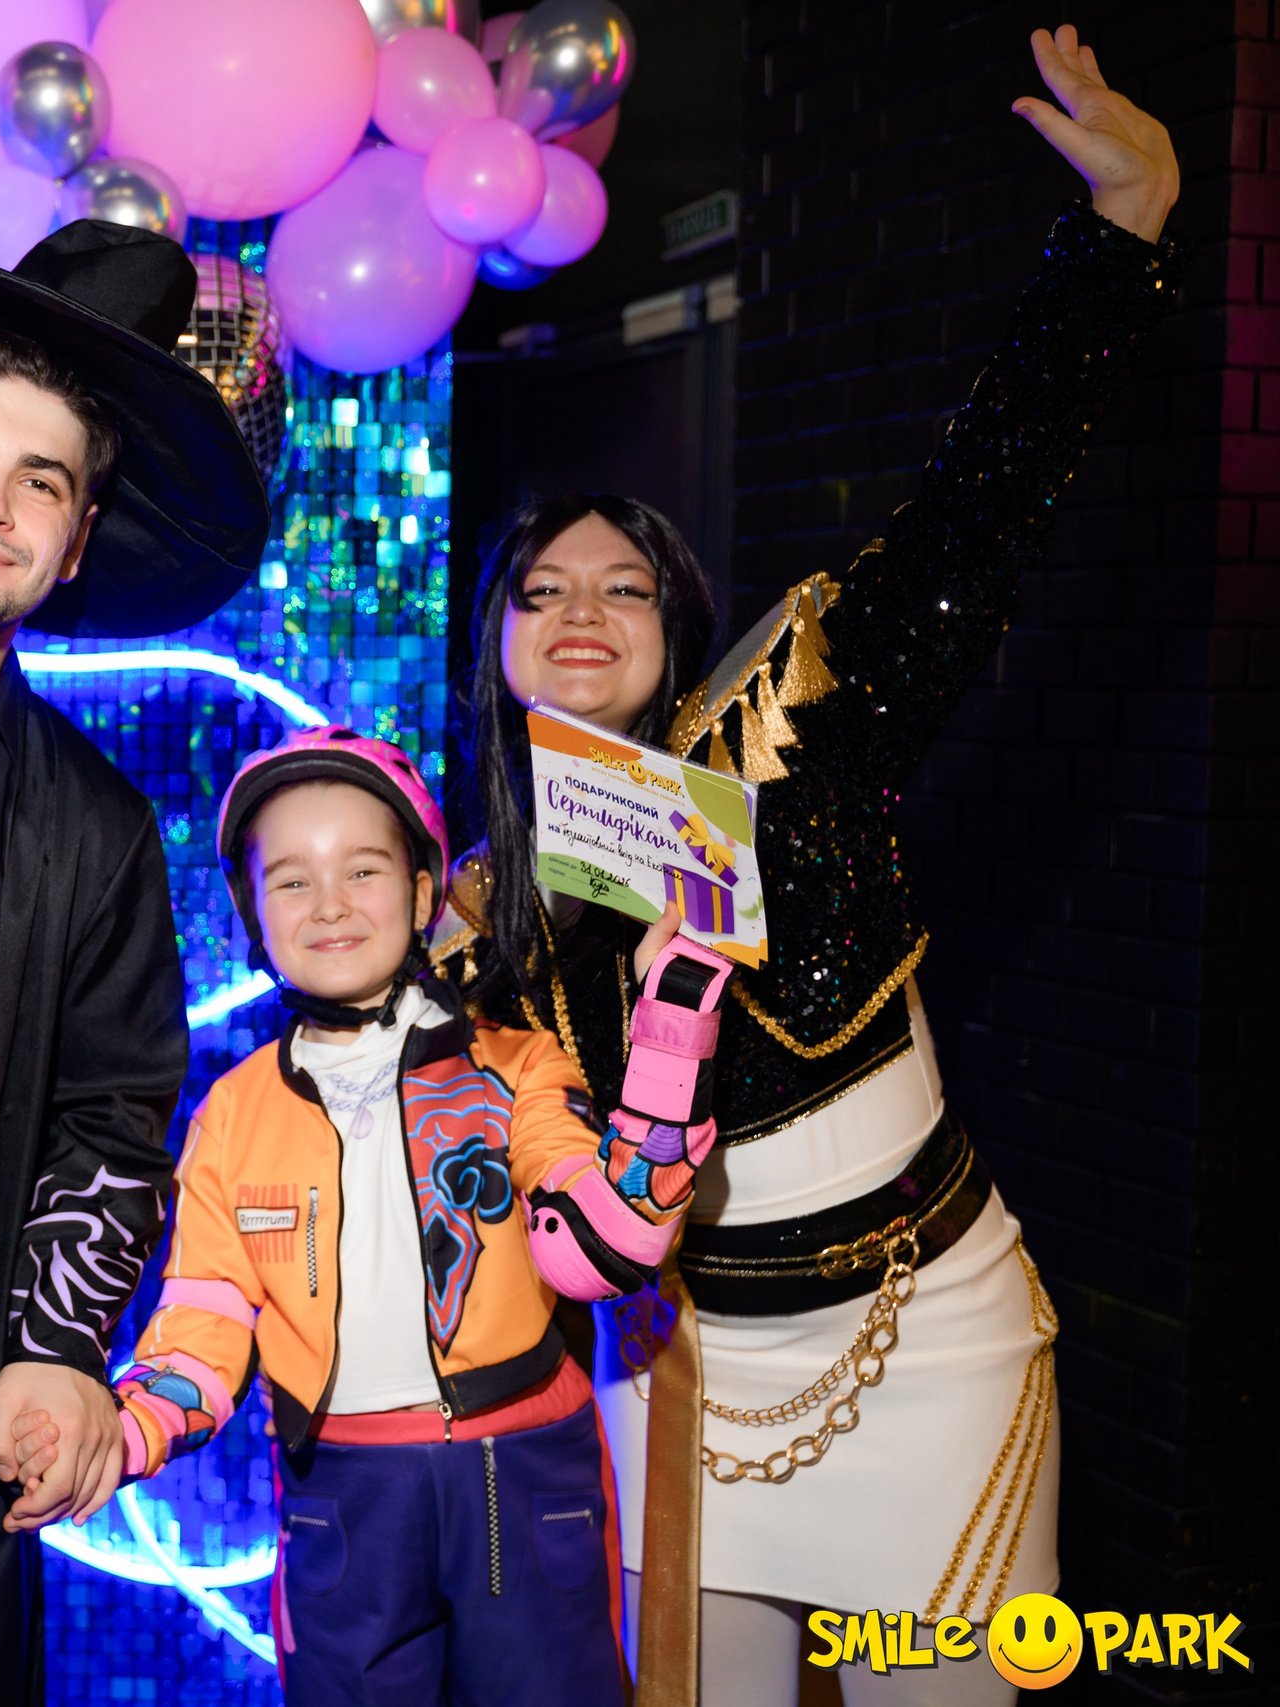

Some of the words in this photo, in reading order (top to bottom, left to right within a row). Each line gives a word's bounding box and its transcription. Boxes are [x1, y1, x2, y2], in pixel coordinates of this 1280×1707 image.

[565, 775, 659, 820] ПОДАРУНКОВИЙ
[646, 769, 685, 798] PARK
[547, 778, 680, 855] Сертифікат
[547, 823, 561, 834] на
